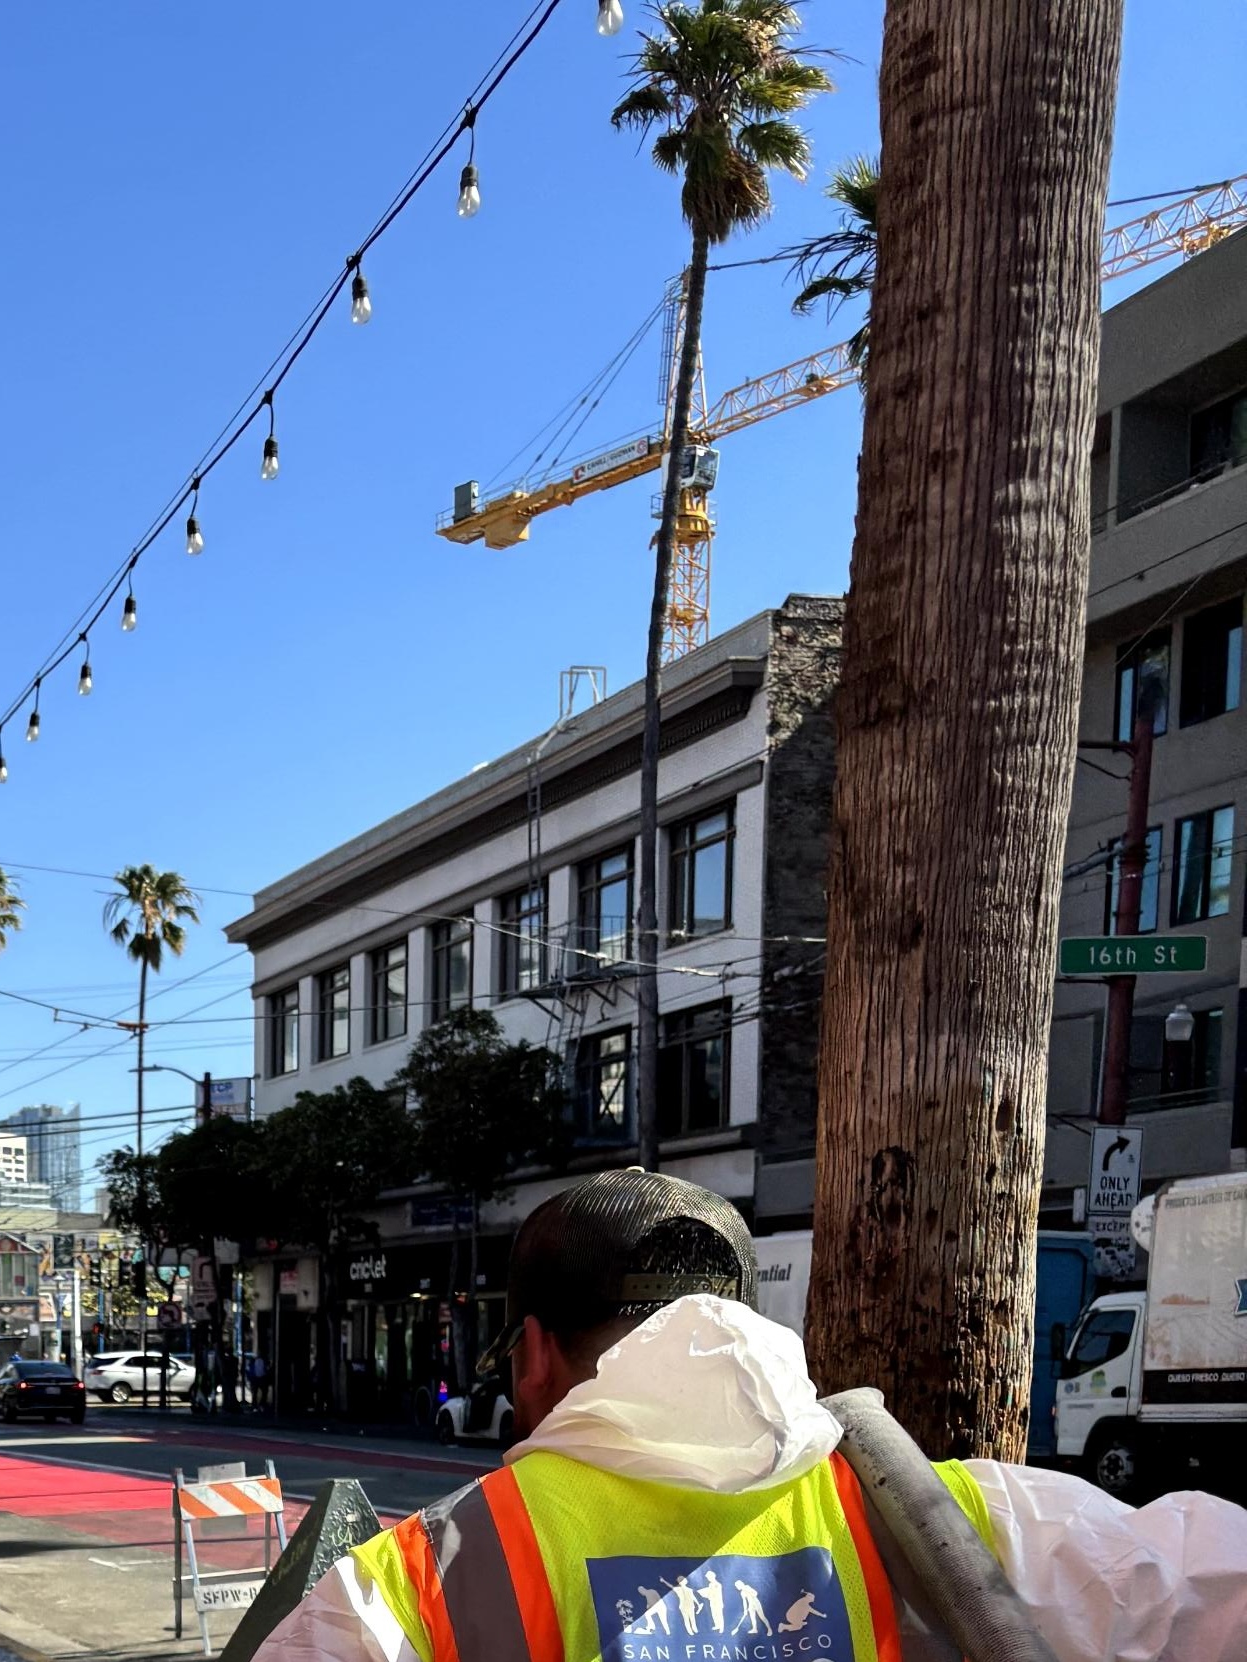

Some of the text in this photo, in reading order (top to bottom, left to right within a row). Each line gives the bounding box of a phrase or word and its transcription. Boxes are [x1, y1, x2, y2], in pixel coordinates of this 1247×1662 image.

[1089, 945, 1178, 965] 16th St
[1100, 1176, 1131, 1190] ONLY
[1191, 1372, 1219, 1383] FRESCO
[624, 1634, 832, 1661] SAN FRANCISCO
